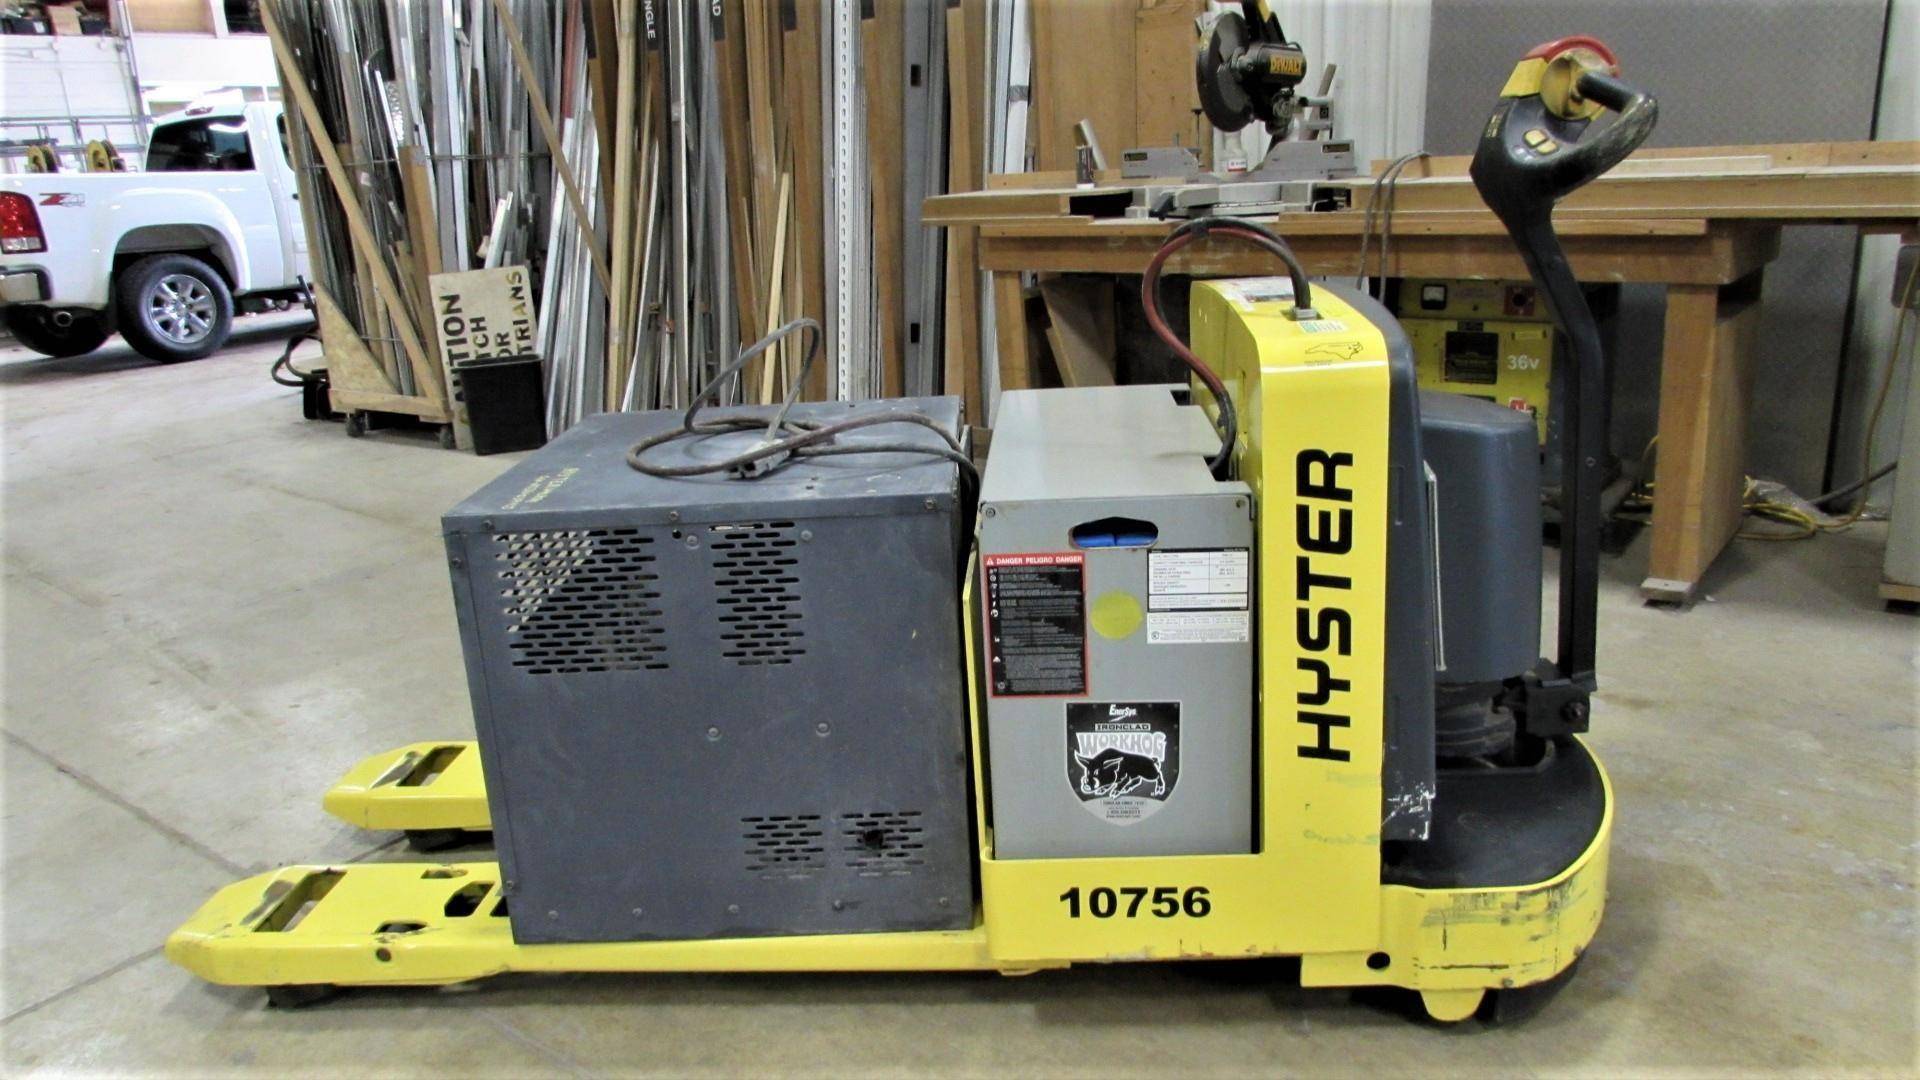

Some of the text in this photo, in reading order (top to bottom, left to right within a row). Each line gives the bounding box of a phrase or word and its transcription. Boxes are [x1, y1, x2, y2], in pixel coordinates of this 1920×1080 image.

[1296, 448, 1353, 762] HYSTER
[1096, 723, 1150, 731] IRONCLAD
[1076, 731, 1167, 762] WORKHOG
[1059, 886, 1211, 918] 10756
